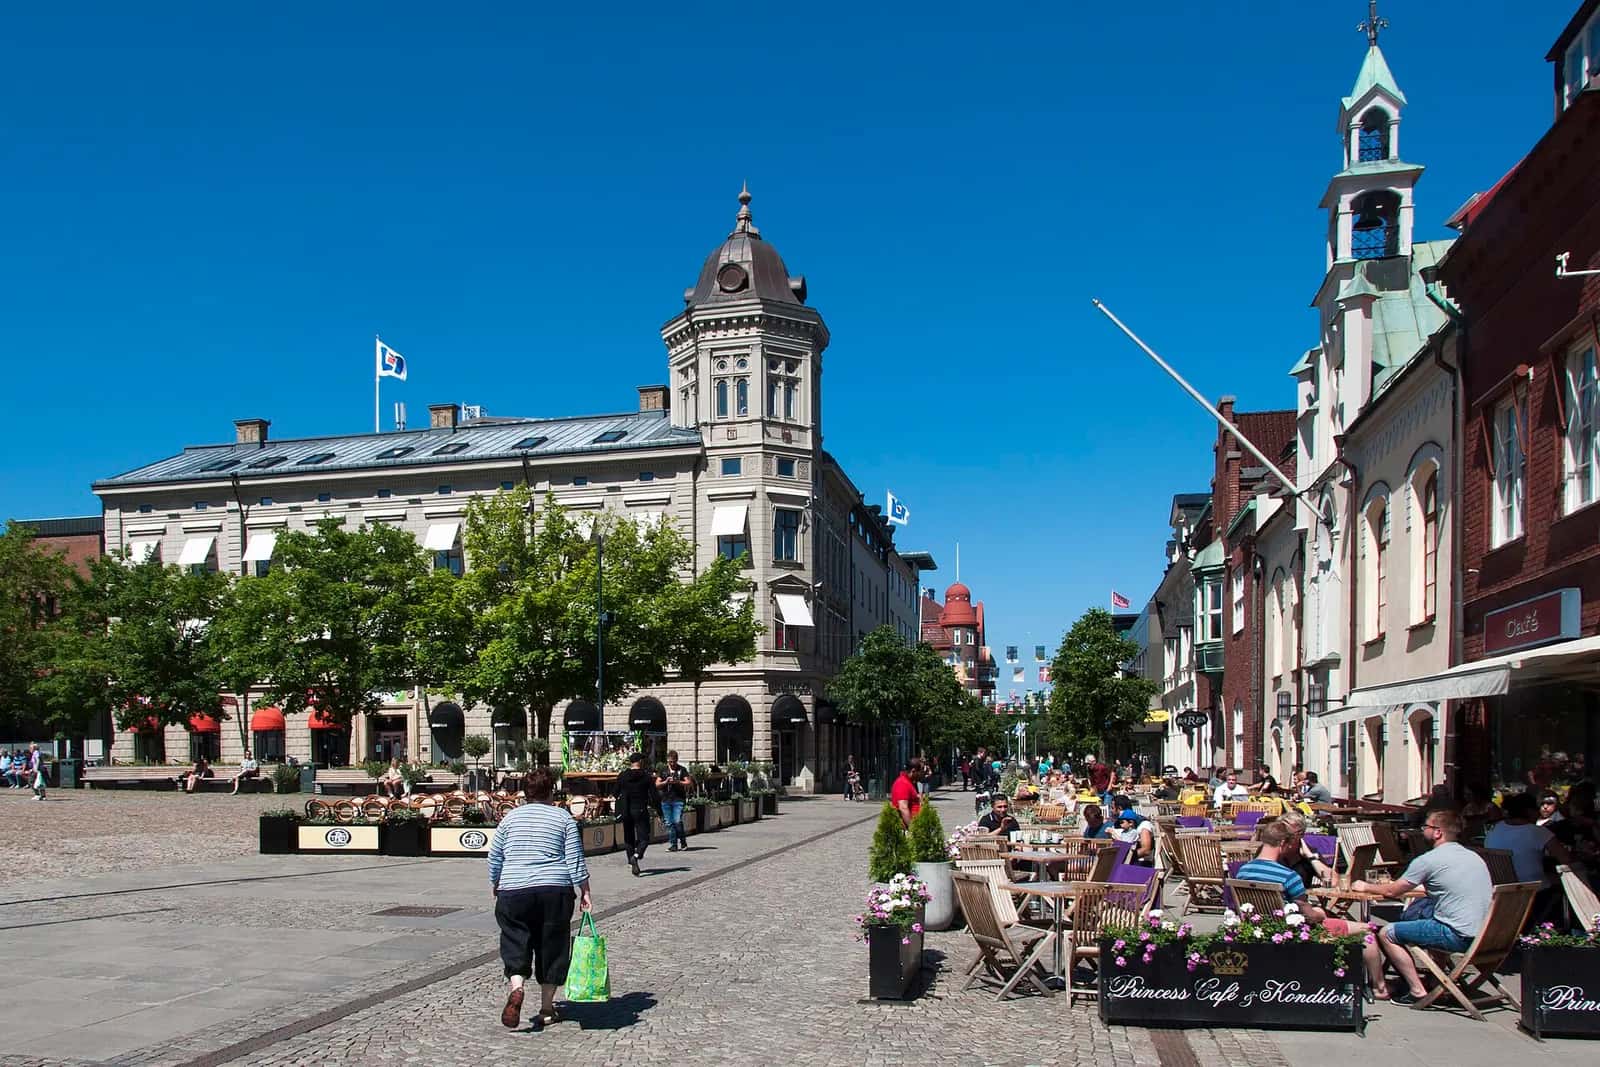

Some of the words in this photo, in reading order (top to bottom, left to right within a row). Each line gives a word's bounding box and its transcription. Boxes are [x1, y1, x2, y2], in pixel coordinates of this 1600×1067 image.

[1506, 608, 1538, 638] Café
[1107, 974, 1191, 1001] Princess
[1194, 978, 1240, 1008] Café
[1239, 990, 1258, 1008] &
[1260, 979, 1355, 1005] Konditori
